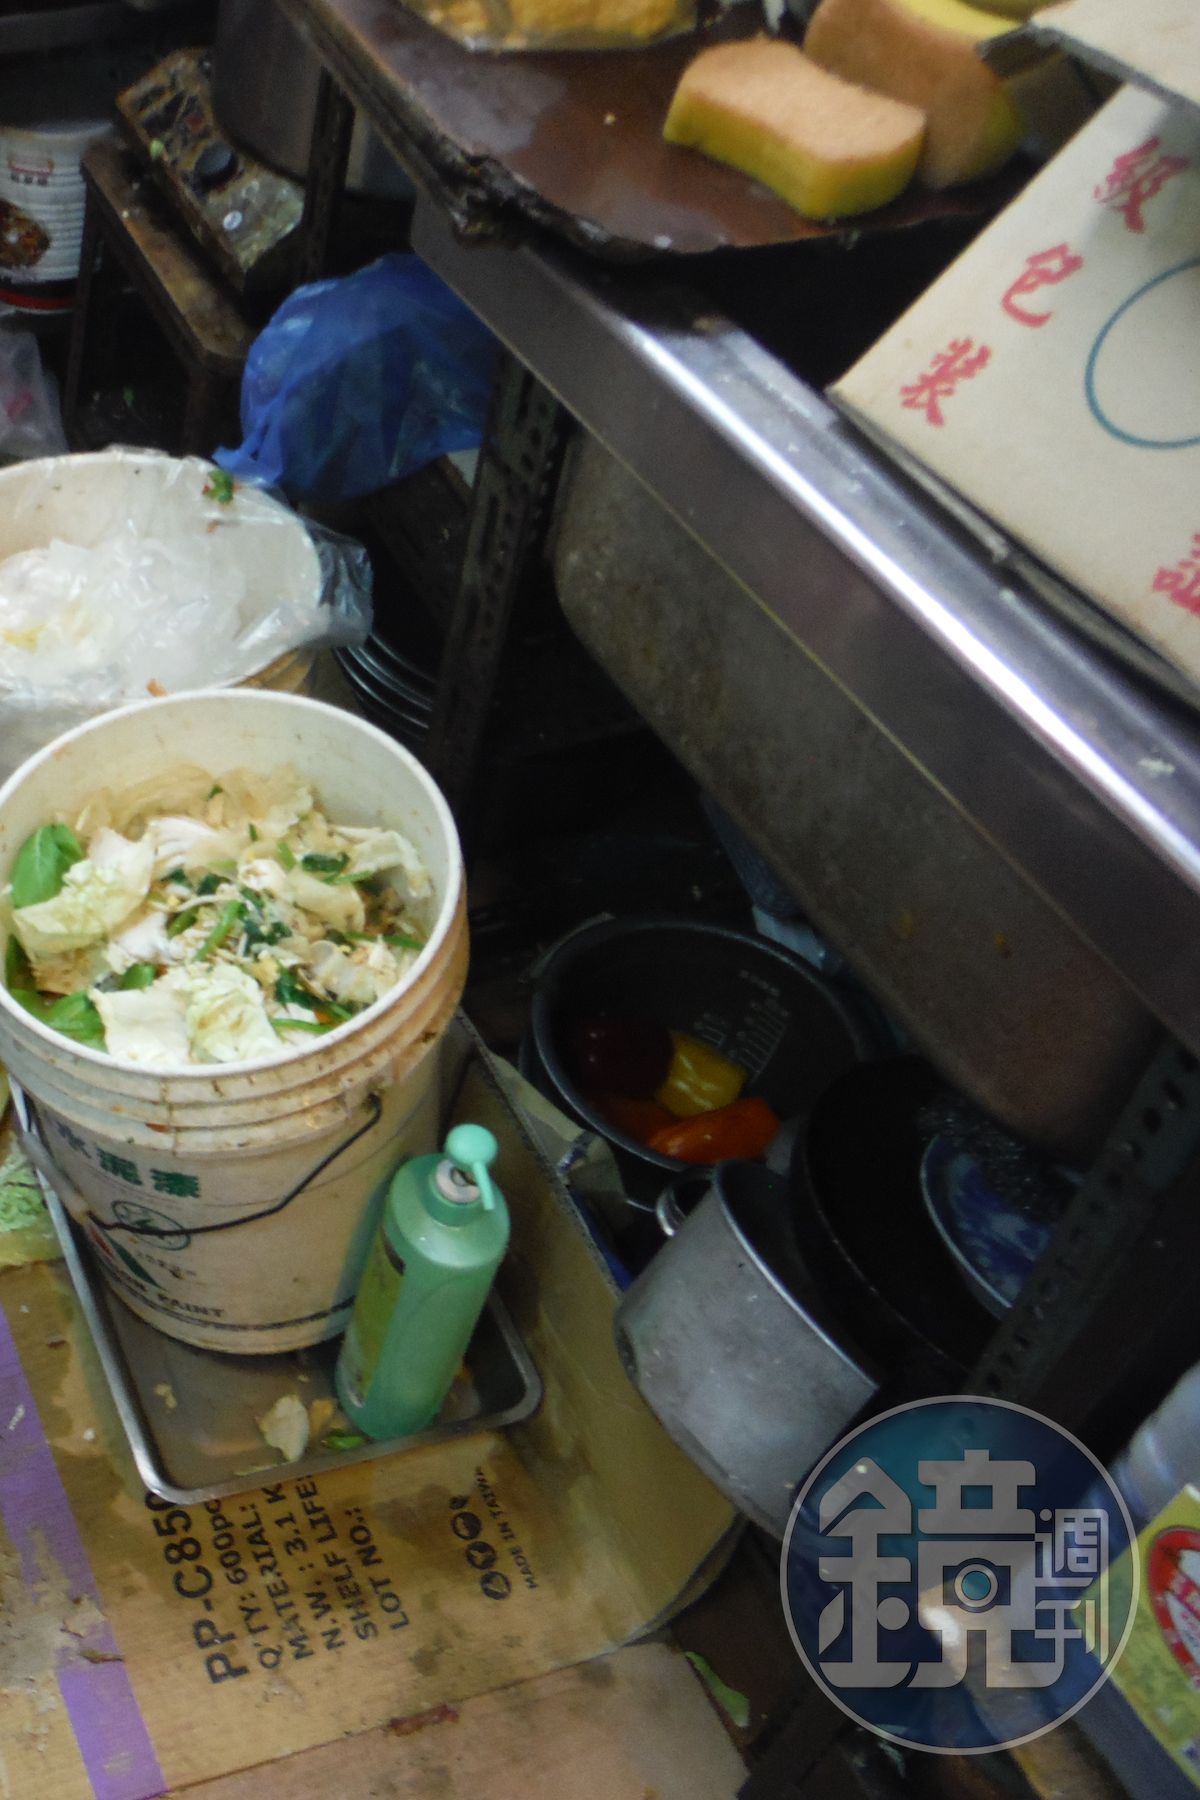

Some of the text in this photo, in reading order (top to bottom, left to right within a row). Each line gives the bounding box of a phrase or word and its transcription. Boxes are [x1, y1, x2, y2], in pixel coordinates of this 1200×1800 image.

[498, 1520, 517, 1541] IN
[239, 1503, 314, 1660] MATERIAL:
[510, 1544, 539, 1589] MADE
[322, 1551, 379, 1641] SHELF
[368, 1575, 411, 1631] LOT
